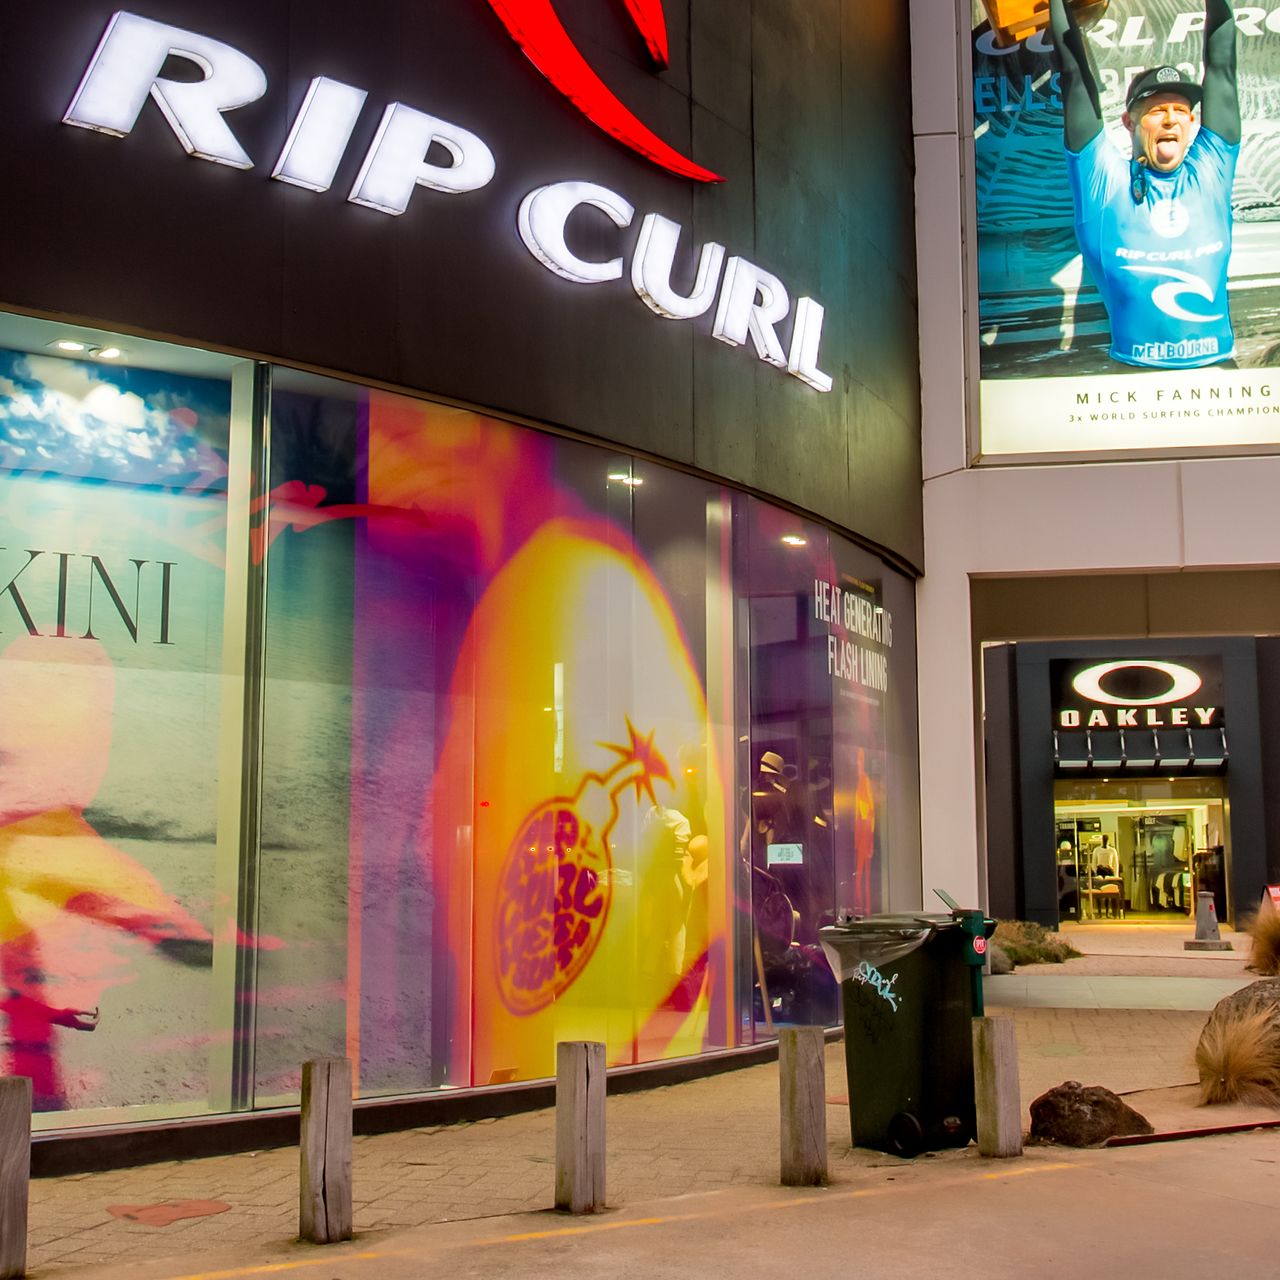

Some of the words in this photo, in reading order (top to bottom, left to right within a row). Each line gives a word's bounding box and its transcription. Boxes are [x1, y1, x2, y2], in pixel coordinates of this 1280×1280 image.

[63, 9, 497, 217] RIP
[517, 179, 834, 394] CURL
[1115, 247, 1146, 259] RIP
[1147, 250, 1194, 262] CURL
[1132, 337, 1218, 360] MELBOURNE
[1076, 391, 1138, 405] MICK
[1156, 384, 1272, 402] FANNING
[1089, 411, 1136, 422] WORLD
[1142, 409, 1201, 419] SURFING
[1207, 405, 1280, 417] CHAMPION
[814, 579, 841, 625] HEAT
[827, 634, 858, 683] FLASH
[860, 650, 888, 693] LINING
[1060, 707, 1216, 727] OAKLEY
